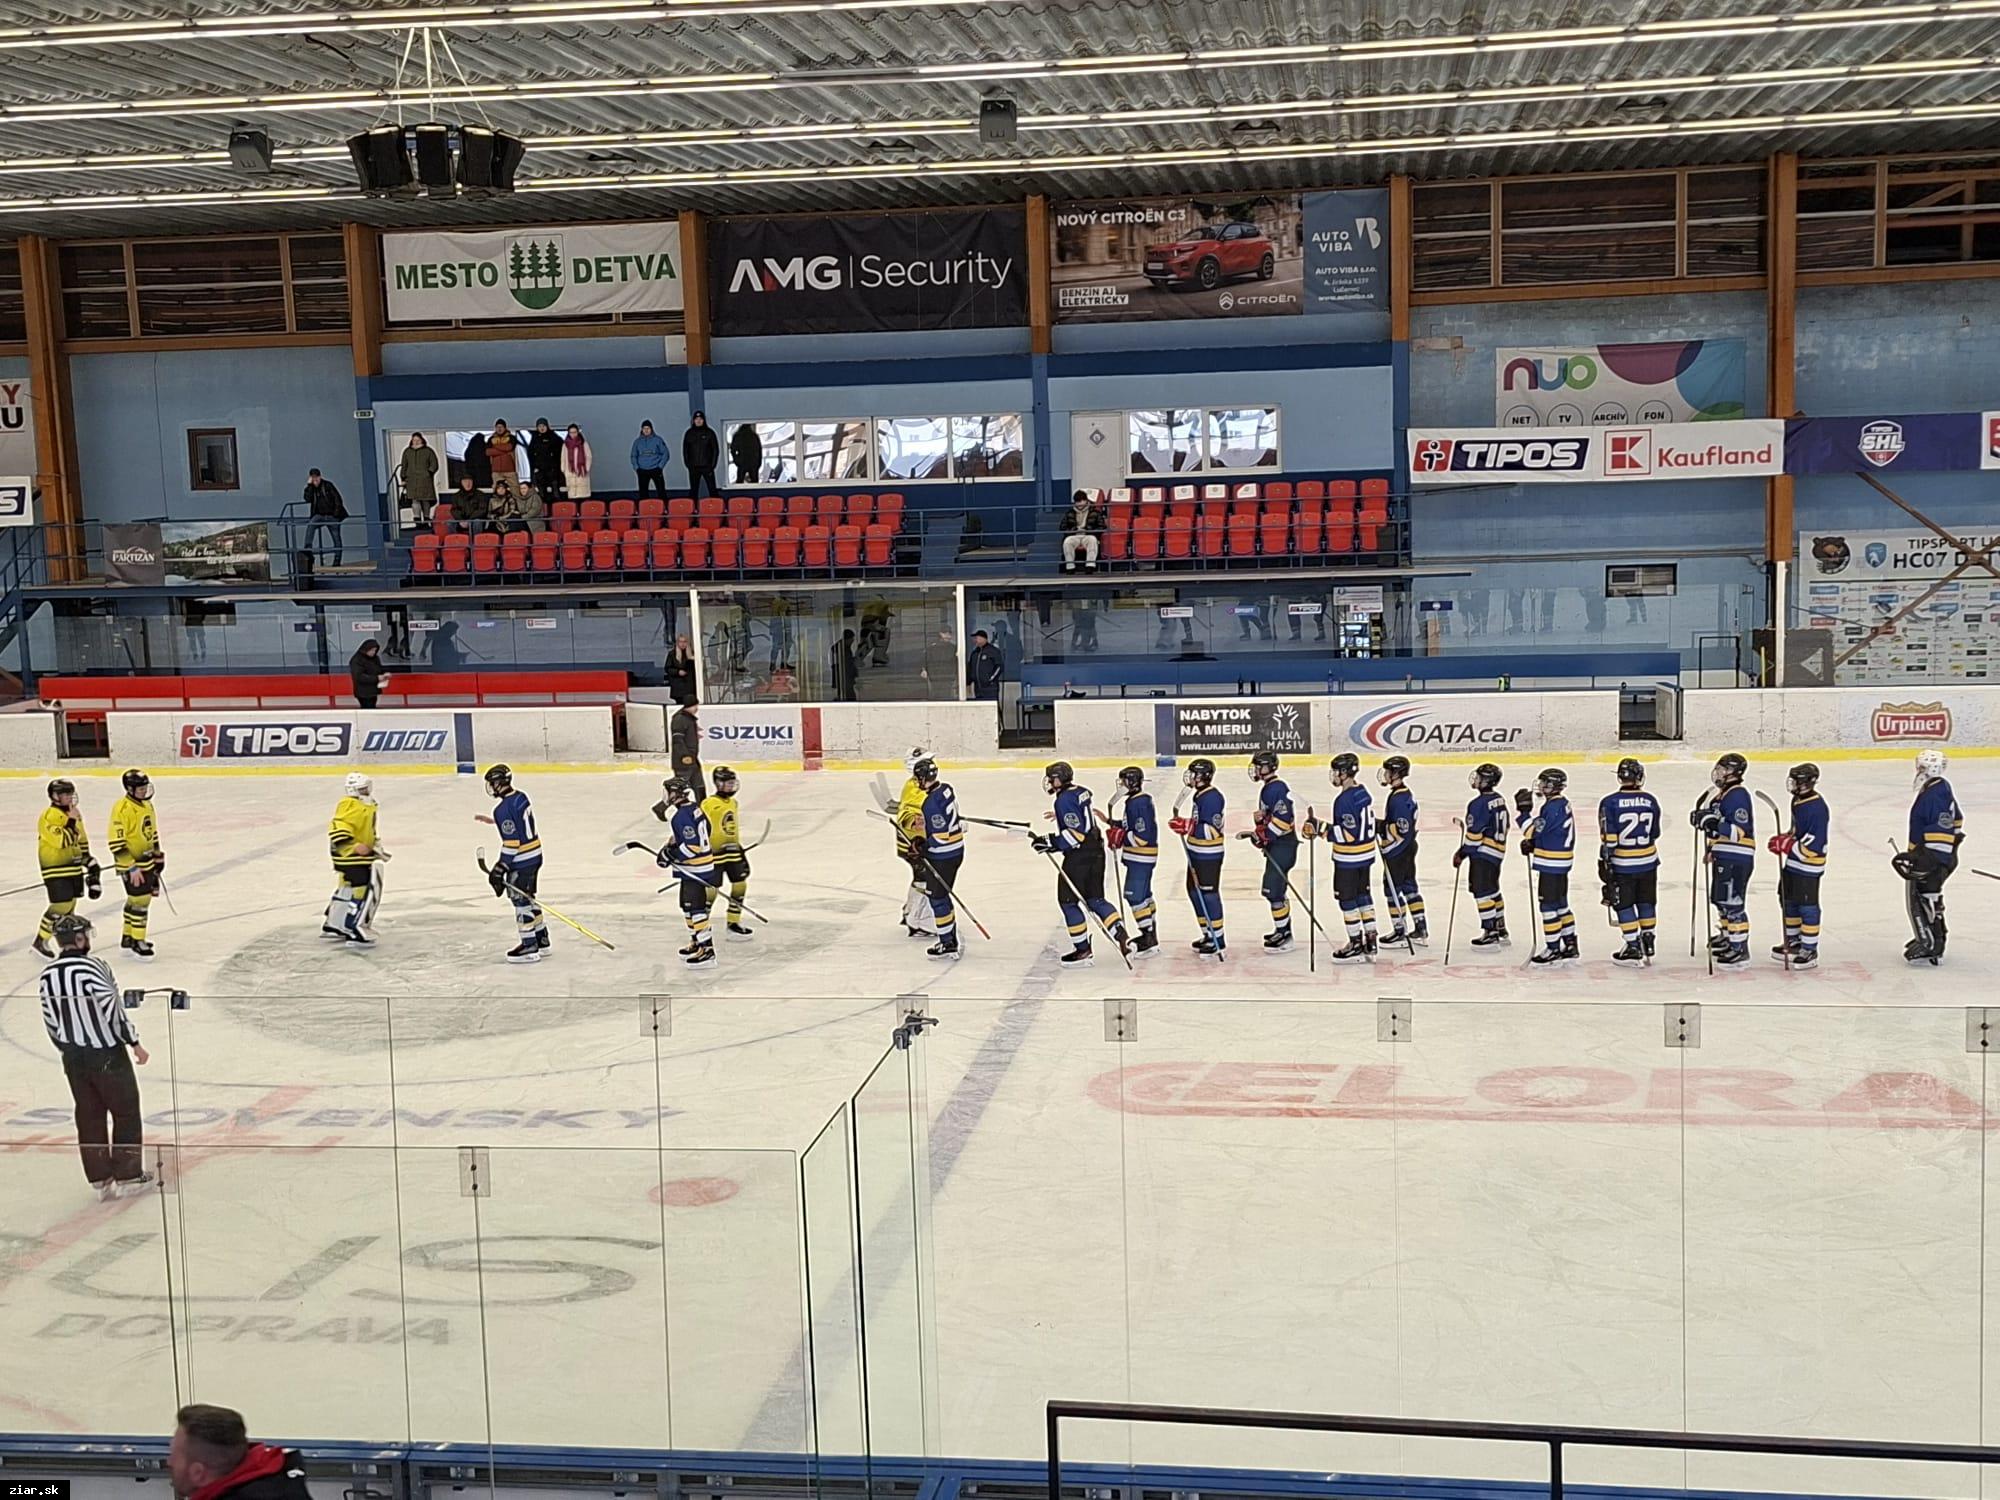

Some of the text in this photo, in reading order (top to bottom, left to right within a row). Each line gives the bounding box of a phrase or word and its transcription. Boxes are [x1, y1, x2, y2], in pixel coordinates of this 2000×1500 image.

[1057, 208, 1186, 227] NOVÝ CITROËN C3
[1312, 231, 1350, 242] AUTO
[1319, 242, 1353, 253] VIBA
[395, 254, 677, 290] MESTO DETVA
[729, 250, 1013, 293] AMG Security
[1315, 267, 1339, 275] AUTO
[1102, 287, 1114, 296] AJ
[1512, 416, 1531, 425] NET
[1558, 415, 1572, 423] TV
[1644, 411, 1665, 420] FON
[1861, 434, 1904, 450] SHL
[1459, 441, 1580, 468] TIPOS
[1658, 444, 1772, 468] Kaufland
[1893, 551, 1948, 569] HC07
[1180, 709, 1251, 720] NABYTOK
[1180, 724, 1252, 736] NA MIERU
[1879, 715, 1944, 734] Urpiner
[225, 727, 344, 753] TIPOS
[708, 726, 794, 740] SUZUKI
[1271, 731, 1301, 740] LUKA
[1405, 723, 1523, 744] DATAcar
[1267, 741, 1305, 750] MASIV
[1618, 812, 1654, 846] 23
[5, 1104, 685, 1130] SOVENSKÝ
[32, 1313, 450, 1345] DOPRAVA
